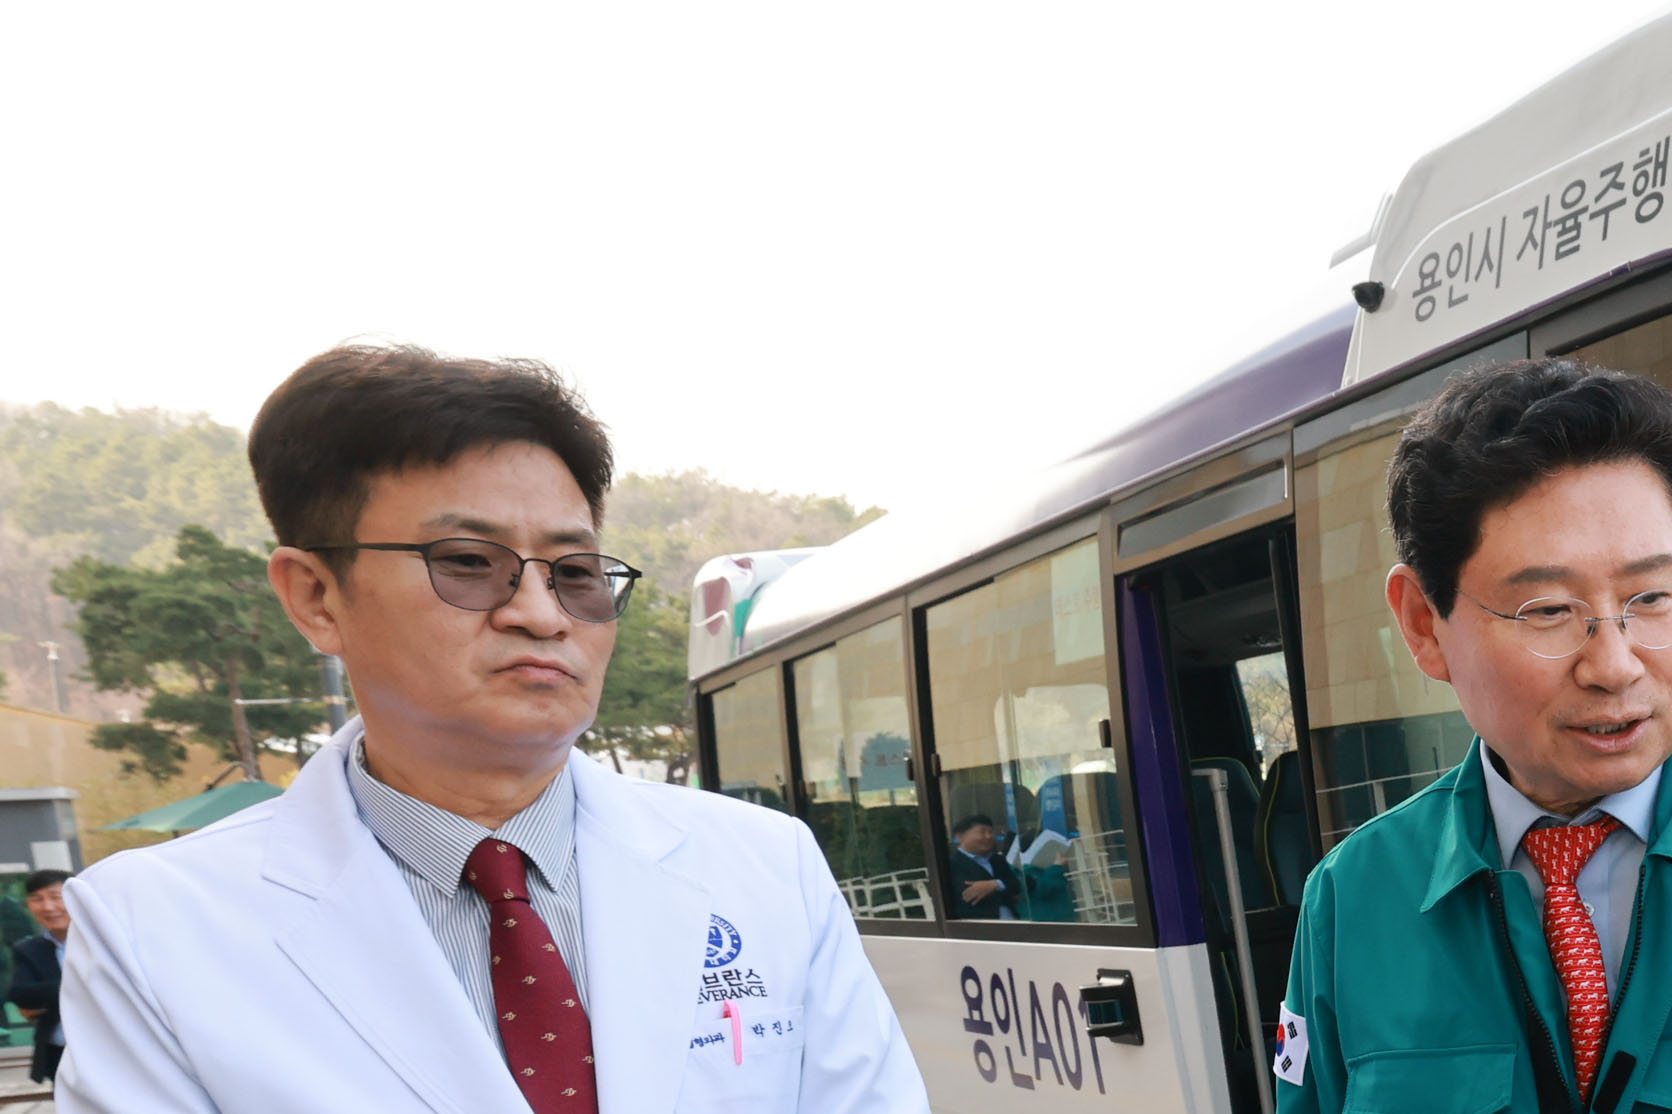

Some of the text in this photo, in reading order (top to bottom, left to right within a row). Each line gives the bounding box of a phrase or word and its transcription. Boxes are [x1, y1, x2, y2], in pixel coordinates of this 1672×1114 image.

[1411, 215, 1507, 323] 용인시
[699, 968, 763, 992] 브란스
[689, 1032, 725, 1050] 형외과
